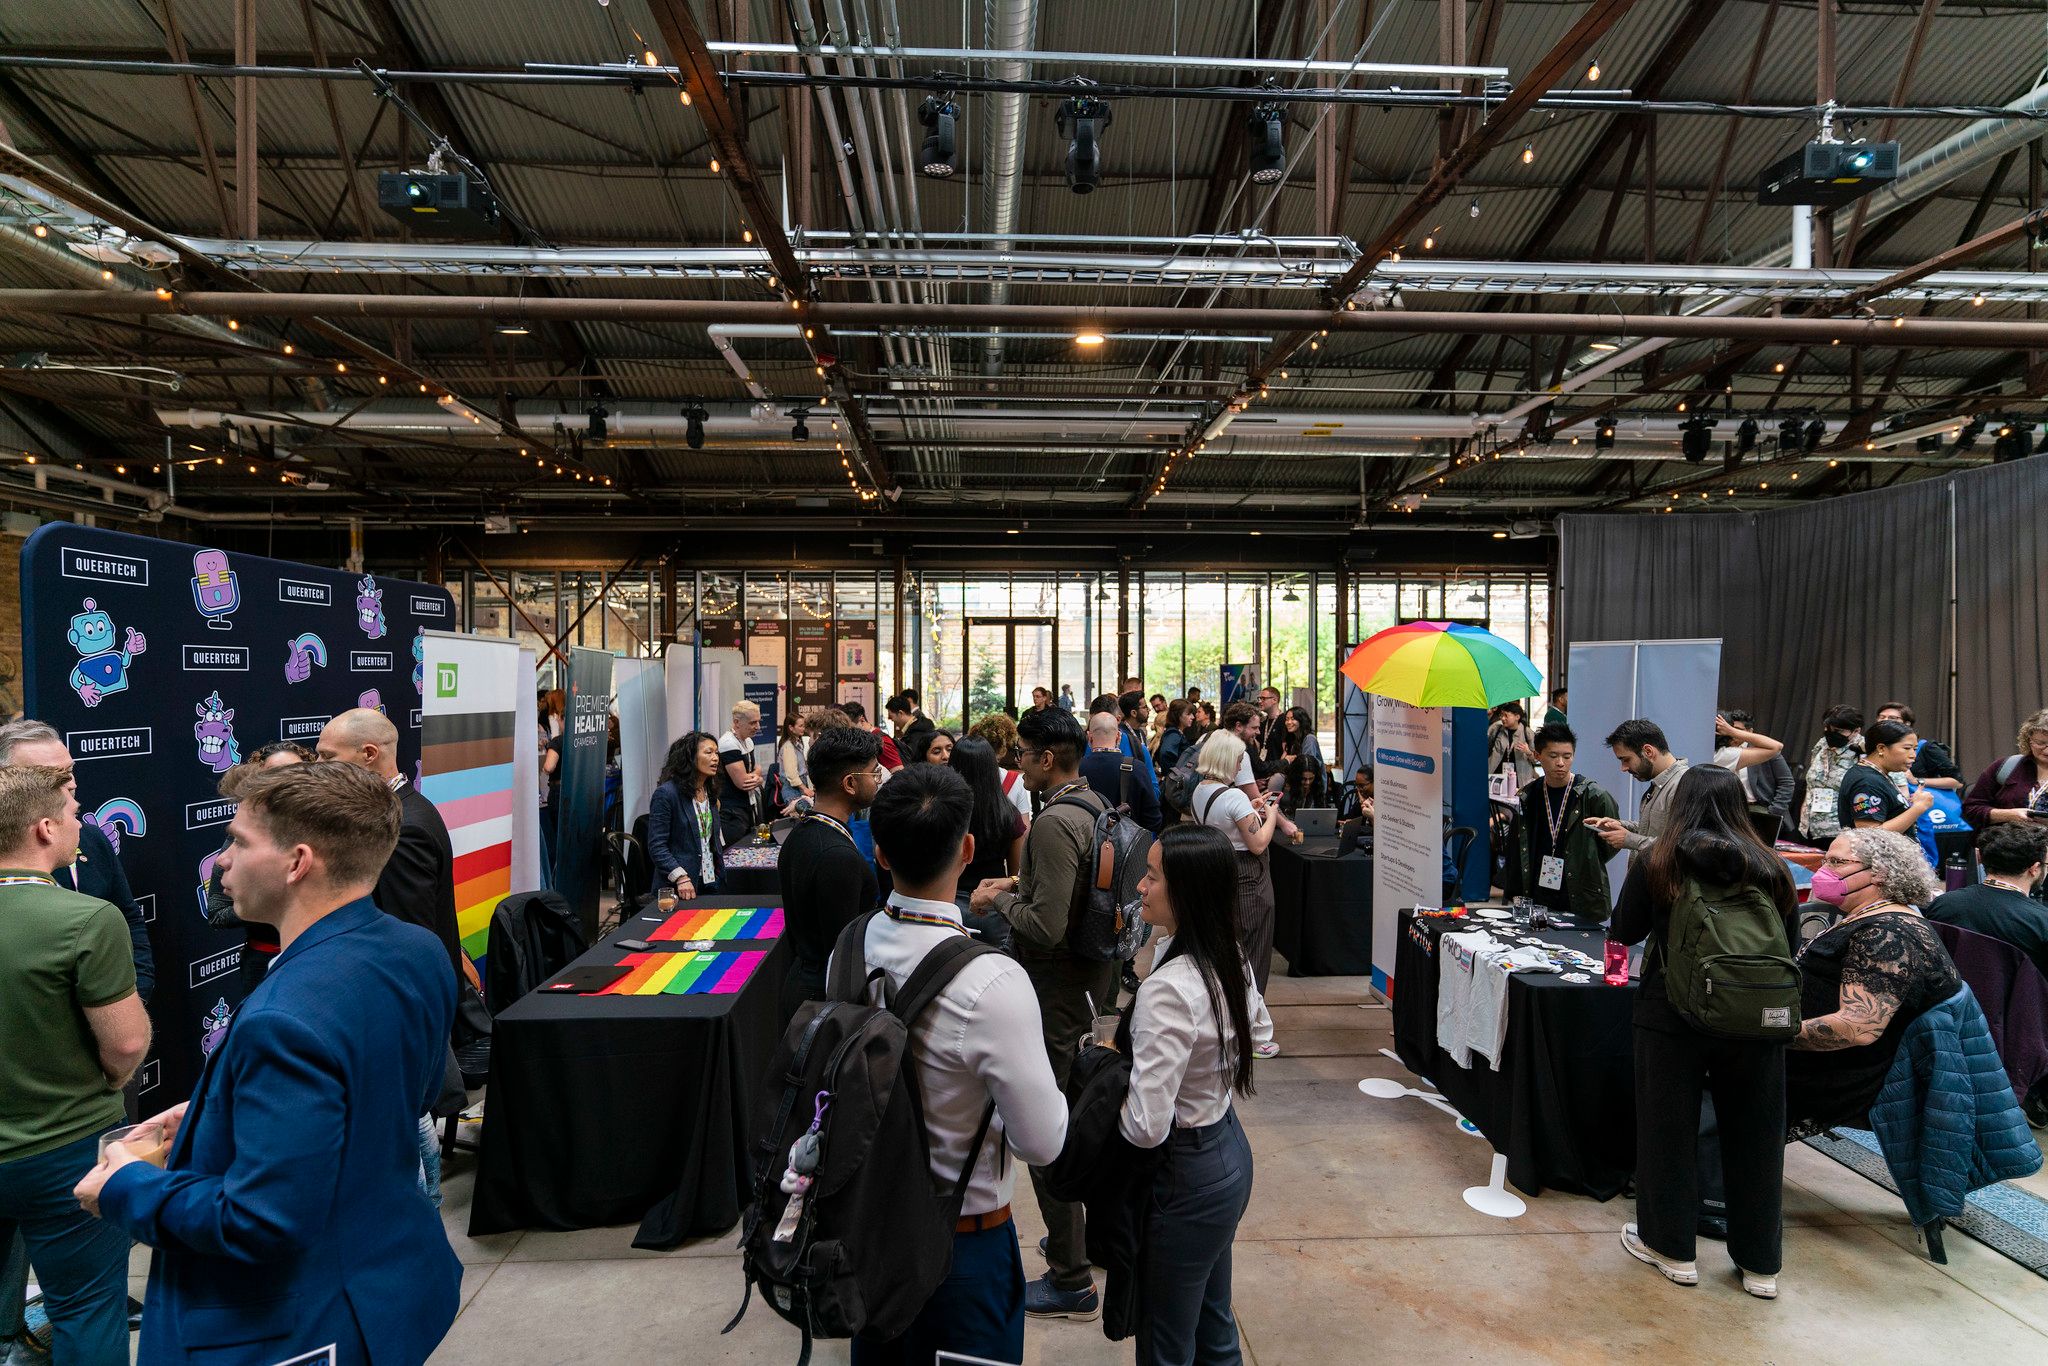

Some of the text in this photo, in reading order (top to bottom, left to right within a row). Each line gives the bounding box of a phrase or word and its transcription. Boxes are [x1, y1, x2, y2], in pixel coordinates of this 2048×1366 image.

[75, 557, 137, 578] QUEERTECH
[287, 585, 325, 600] QUEERTECH
[415, 601, 441, 612] QUEERTECH
[193, 652, 241, 664] QUEERTECH
[356, 656, 388, 666] QUEERTECH
[796, 647, 803, 662] 1
[439, 669, 456, 691] TD
[795, 672, 803, 688] 2
[575, 695, 610, 713] PREMIER
[1376, 695, 1393, 707] Grow
[574, 714, 606, 734] HEALTH
[80, 735, 140, 752] QUEERTECH
[200, 952, 240, 977] QUEERTEC
